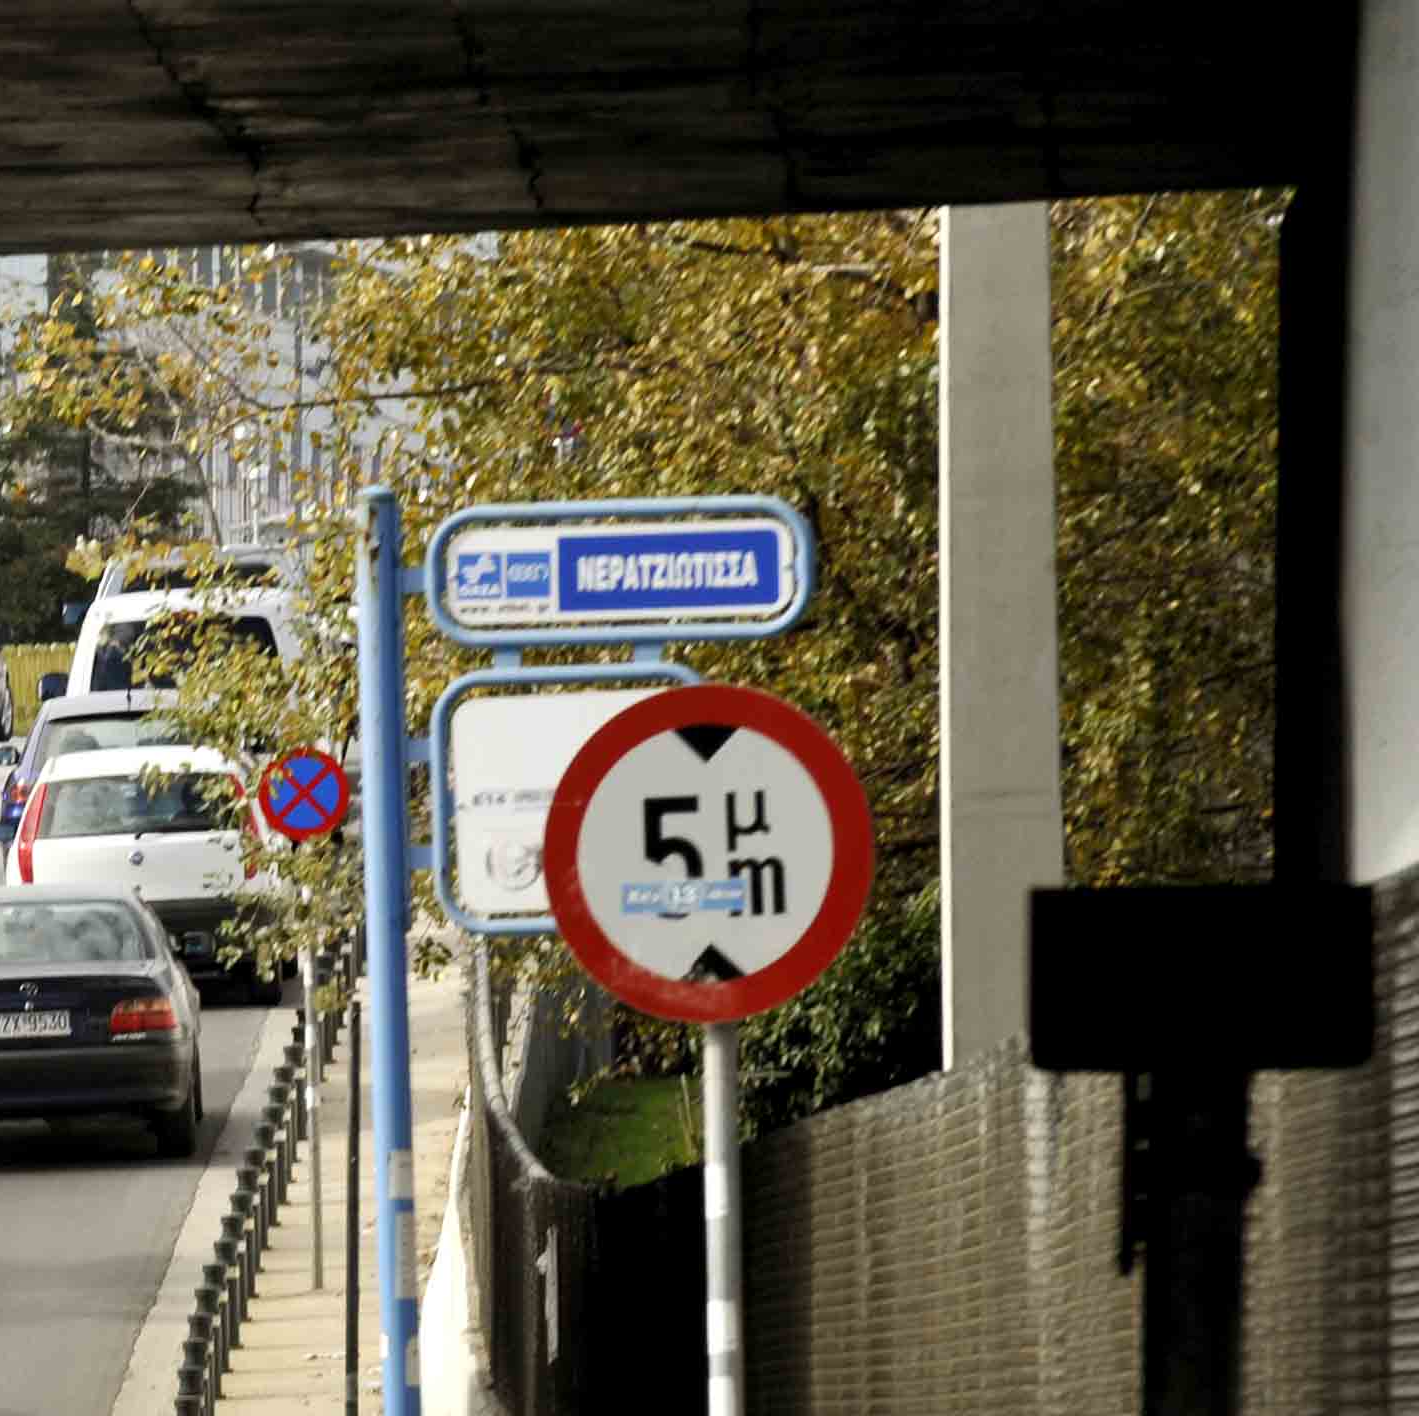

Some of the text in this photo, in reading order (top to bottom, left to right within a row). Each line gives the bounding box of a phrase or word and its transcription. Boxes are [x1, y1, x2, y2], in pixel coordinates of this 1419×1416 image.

[575, 550, 760, 593] ΝΕΡΑΤΖΙΩΤΙΣΣΑ
[643, 795, 703, 920] 5
[728, 855, 787, 917] m
